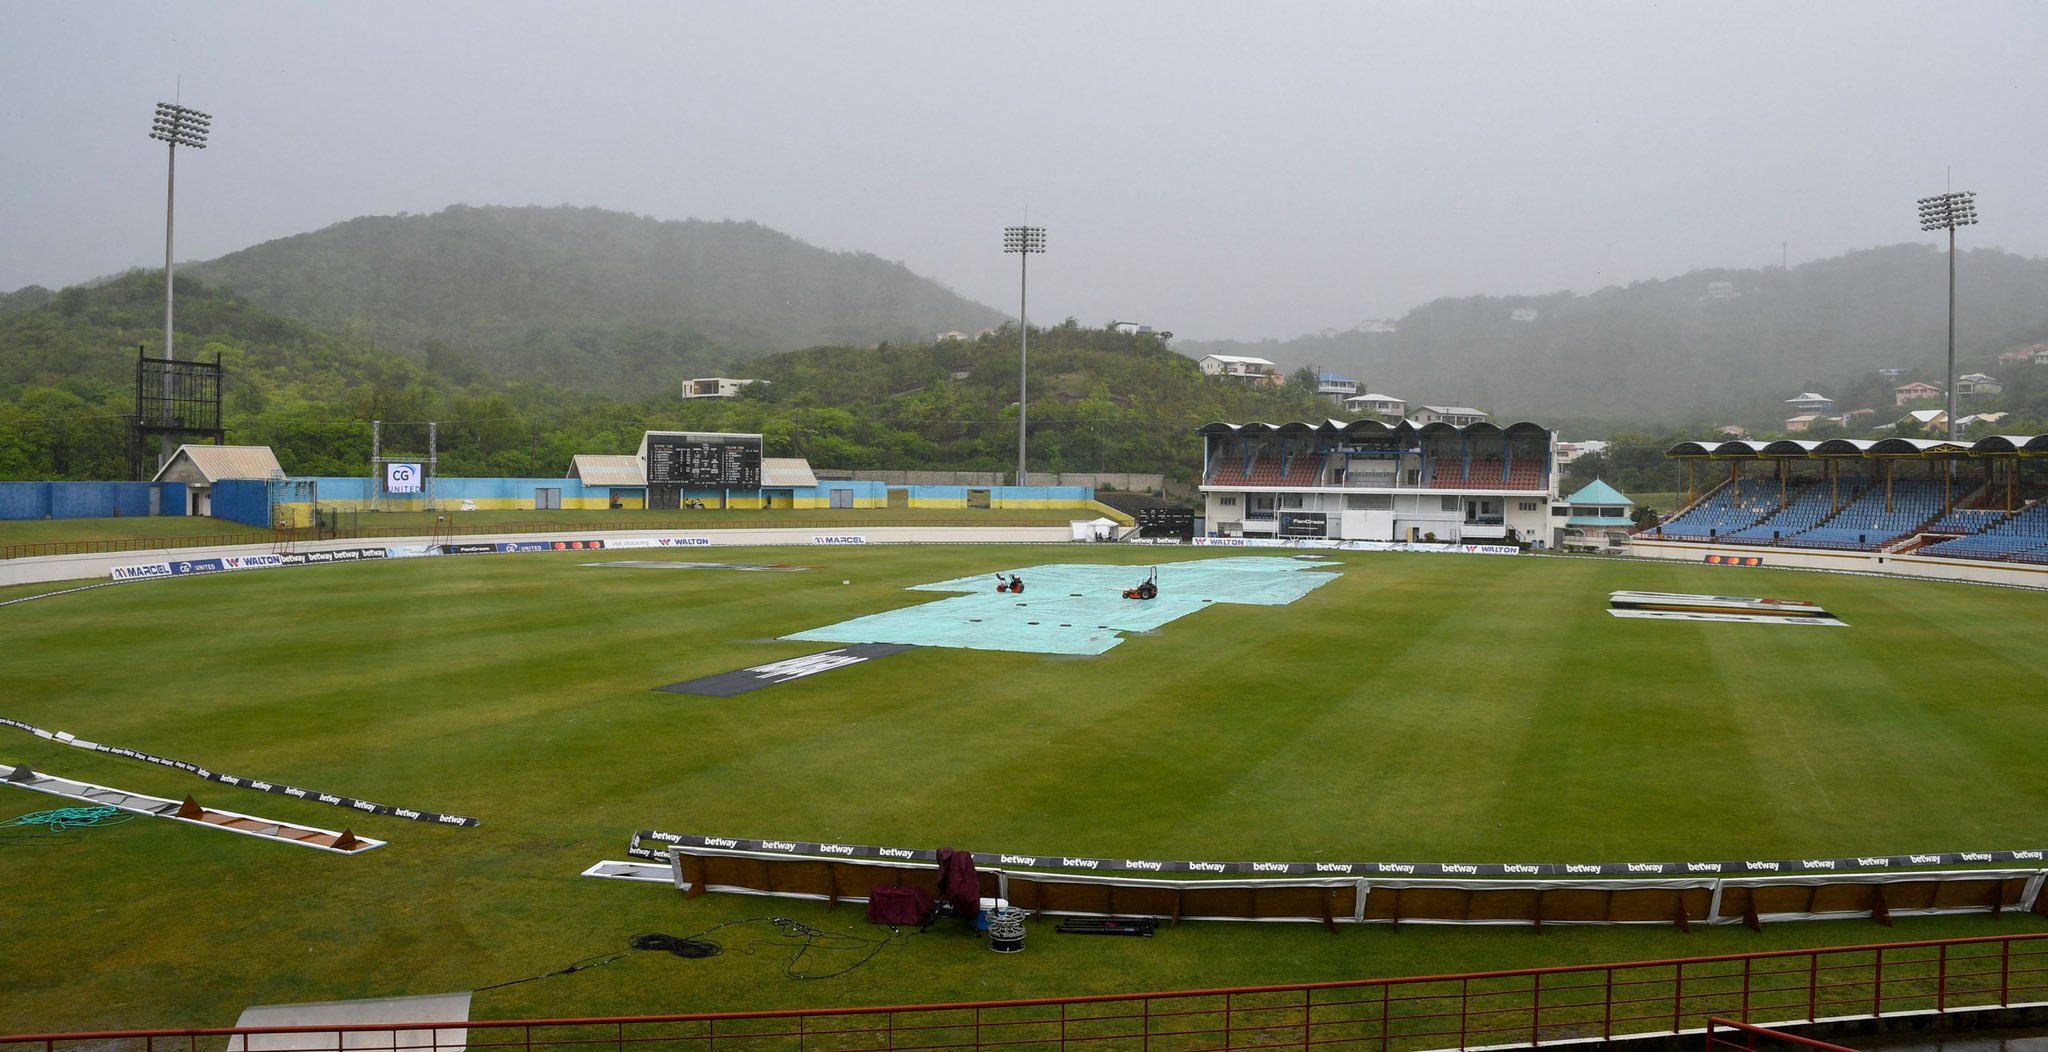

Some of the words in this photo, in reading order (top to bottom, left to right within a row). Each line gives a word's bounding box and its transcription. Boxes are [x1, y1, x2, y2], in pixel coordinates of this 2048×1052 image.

[393, 470, 408, 481] CG
[388, 485, 421, 493] UNITED
[1130, 537, 1154, 545] betway
[1156, 537, 1181, 545] betway
[333, 550, 359, 560] betway
[361, 548, 386, 557] betway
[1481, 546, 1517, 554] WALTON
[243, 555, 281, 567] WALTON
[280, 555, 306, 566] betway
[307, 552, 333, 563] betway
[127, 564, 170, 578] MARCEL
[195, 563, 216, 571] UNITED
[220, 774, 240, 786] betway
[251, 780, 272, 792] betway
[285, 786, 306, 799] betway
[319, 793, 341, 806] betway
[353, 800, 377, 813] betway
[395, 807, 420, 820] betway
[439, 814, 466, 826] betway
[652, 830, 682, 843] betway
[704, 836, 738, 849] betway
[762, 840, 796, 852] betway
[629, 847, 650, 856] betway
[653, 849, 672, 859] betwa
[820, 844, 854, 855] betway
[879, 847, 914, 859] betway
[2012, 850, 2043, 860] betway
[1001, 855, 1036, 866] betway
[1858, 857, 1889, 867] betway
[1910, 854, 1941, 864] betway
[1961, 852, 1992, 862] betway
[1063, 858, 1098, 869] betway
[1126, 860, 1161, 871] betway
[1189, 862, 1225, 872] betway
[1253, 862, 1289, 872] betway
[1316, 863, 1352, 873] betway
[1379, 863, 1415, 873] betway
[1441, 864, 1477, 874] betway
[1504, 864, 1539, 874] betway
[1566, 864, 1601, 874] betway
[1628, 863, 1663, 873] betway
[1687, 862, 1722, 873] betway
[1746, 860, 1780, 871] betway
[1803, 860, 1835, 870] betway
